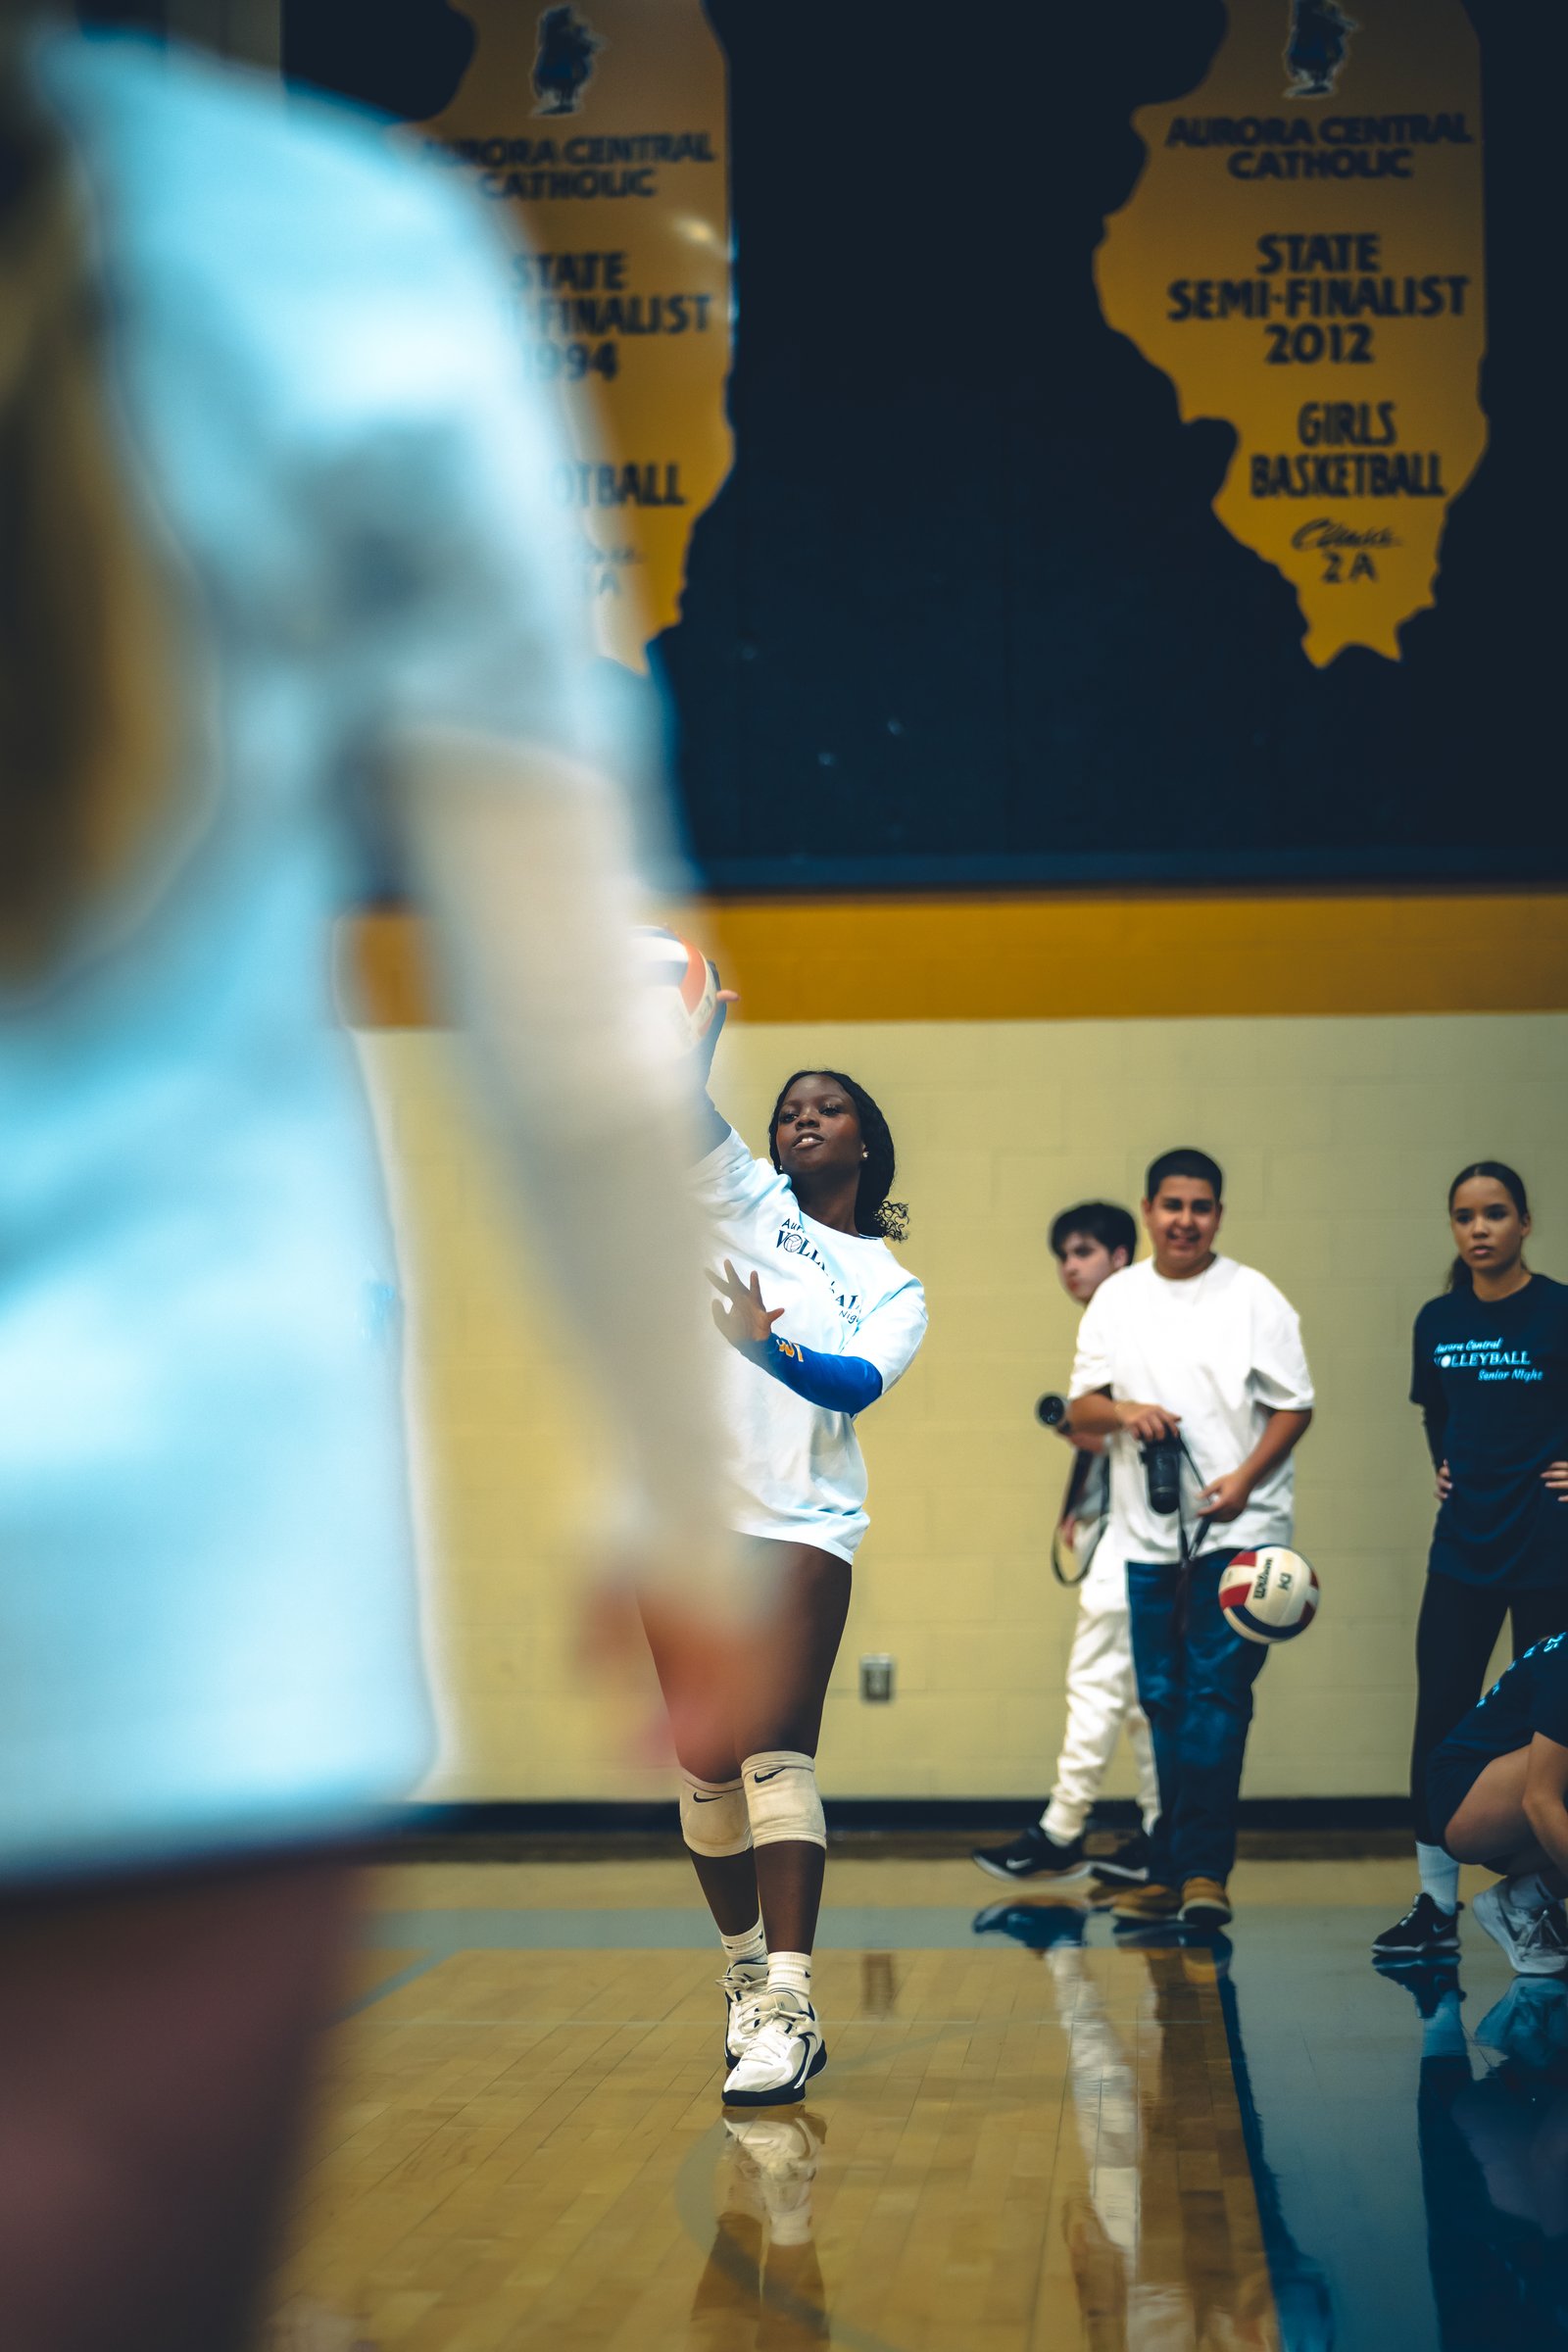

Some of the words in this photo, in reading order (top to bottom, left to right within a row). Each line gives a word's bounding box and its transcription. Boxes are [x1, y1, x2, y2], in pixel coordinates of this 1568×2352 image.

[563, 131, 715, 165] CENTRAL
[1165, 117, 1315, 147] AURORA
[1318, 113, 1473, 144] CENTRAL
[478, 167, 656, 199] CATHOLIC
[1227, 148, 1414, 179] CATHOLIC
[512, 251, 626, 291] STATE
[1256, 233, 1381, 275] STATE
[1166, 275, 1470, 321] SEMI-FINALIST
[1263, 322, 1375, 365] 2012
[1297, 401, 1397, 447] GIRLS
[551, 461, 686, 508] OTBALL
[1250, 451, 1446, 499] BASKETBALL
[781, 1218, 805, 1233] Aur
[1466, 1337, 1502, 1350] Central
[1478, 1369, 1509, 1381] Senior
[1511, 1368, 1544, 1383] Night
[1252, 1557, 1273, 1599] Wilson
